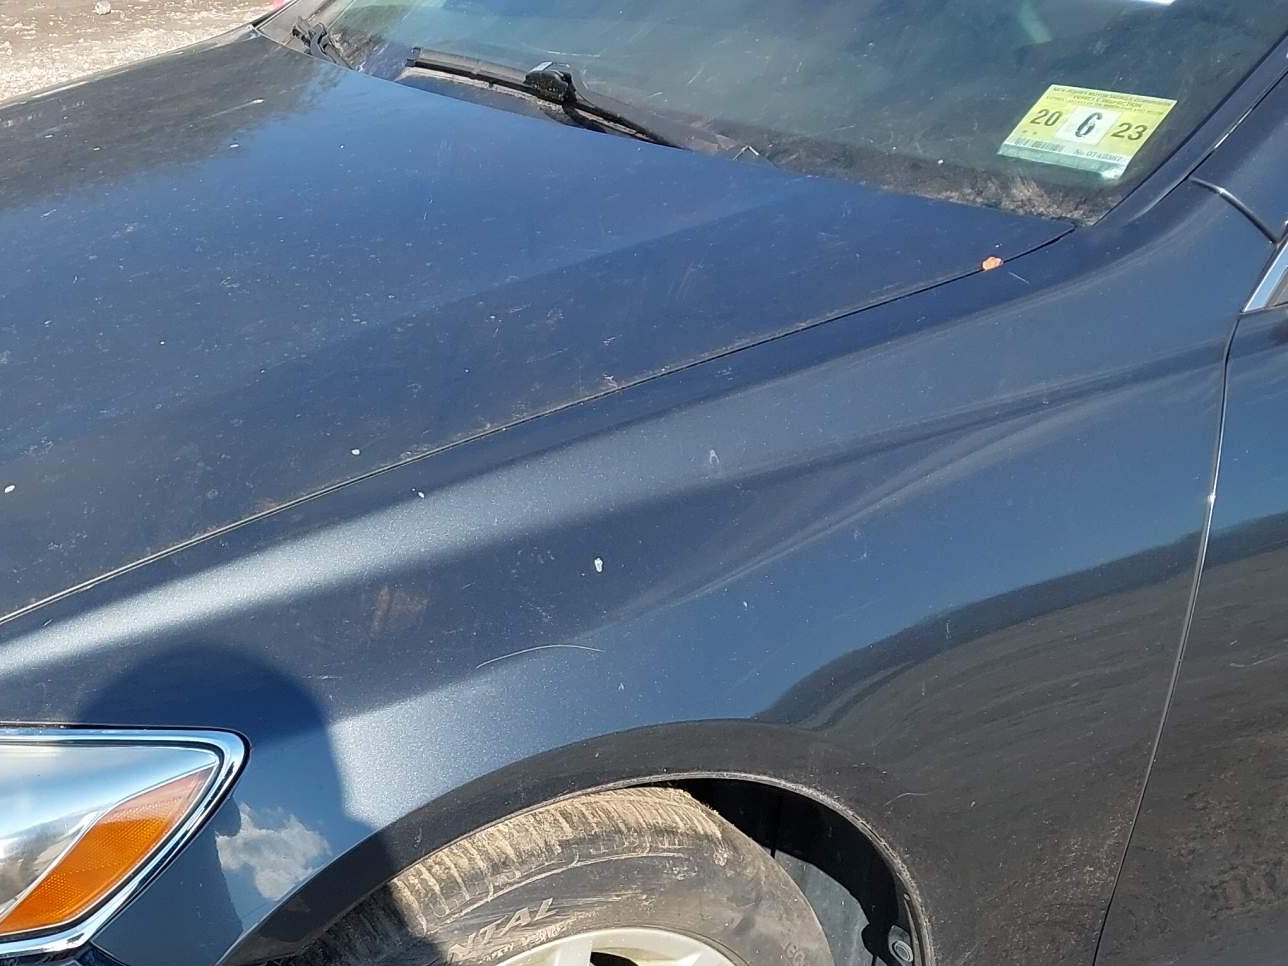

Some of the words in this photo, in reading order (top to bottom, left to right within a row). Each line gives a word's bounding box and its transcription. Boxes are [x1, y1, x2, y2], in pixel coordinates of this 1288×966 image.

[1030, 108, 1062, 127] 20
[1075, 112, 1103, 138] 6
[1111, 122, 1149, 141] 23
